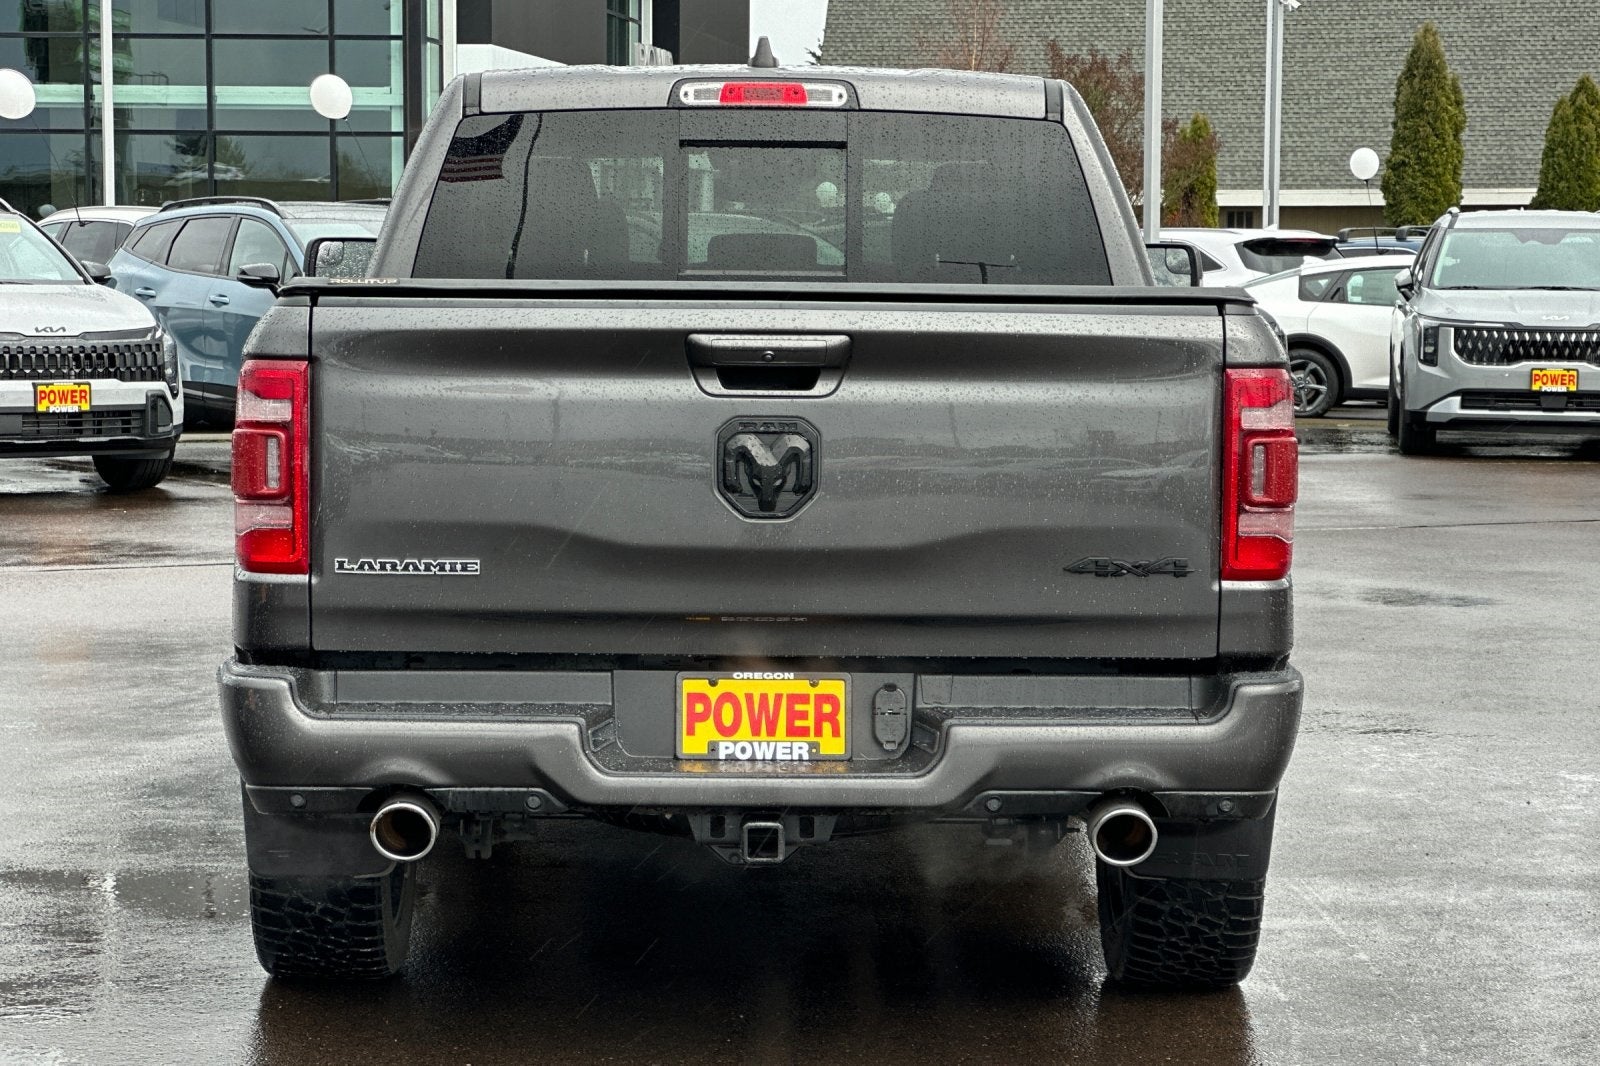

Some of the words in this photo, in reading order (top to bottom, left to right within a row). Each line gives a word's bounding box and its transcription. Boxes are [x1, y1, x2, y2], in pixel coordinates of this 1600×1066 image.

[1533, 374, 1576, 386] POWER
[38, 389, 88, 405] POWER
[738, 422, 798, 432] RAM
[335, 558, 480, 574] LARAMIE
[732, 672, 795, 680] OREGON
[685, 691, 842, 738] POWER
[718, 741, 809, 760] POWER
